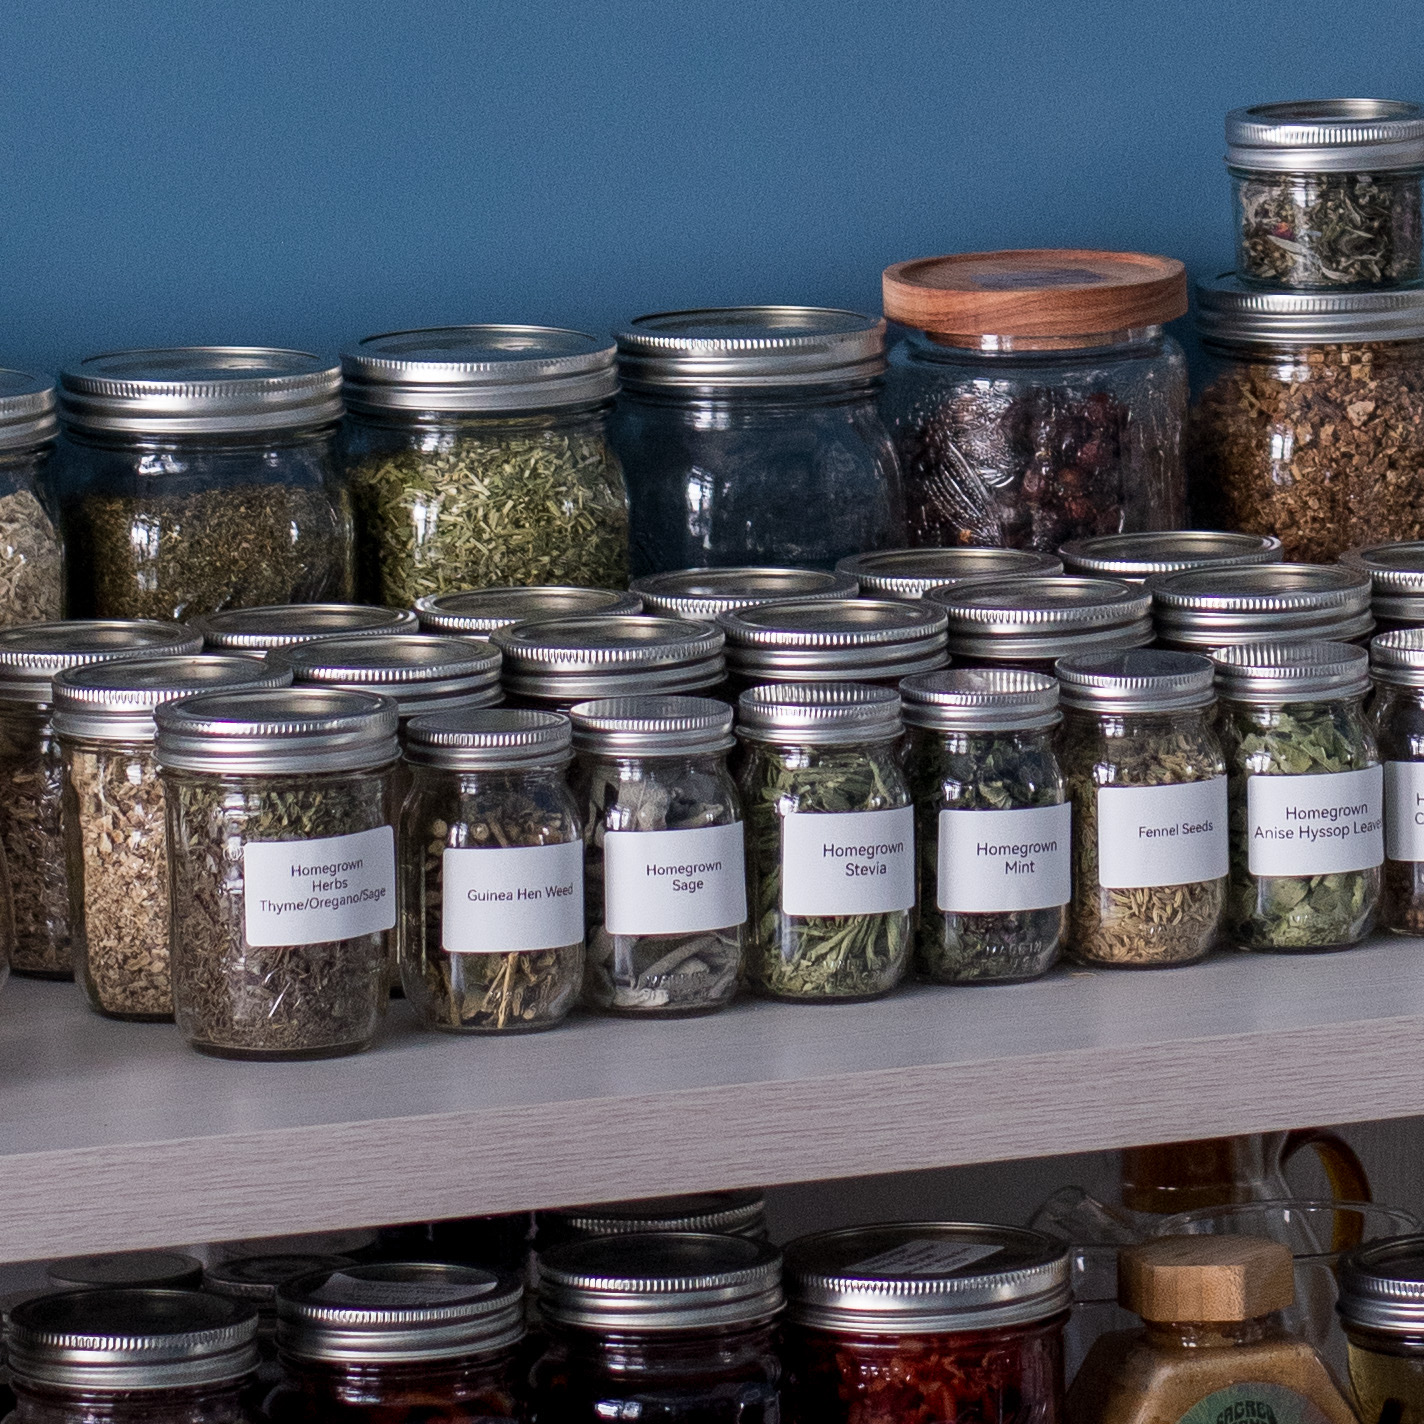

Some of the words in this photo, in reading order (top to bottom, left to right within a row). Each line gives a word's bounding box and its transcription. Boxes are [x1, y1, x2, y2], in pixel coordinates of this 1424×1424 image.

[1286, 803, 1368, 822] Homegrown
[1139, 824, 1179, 839] Fennel
[1182, 819, 1213, 835] Seeds
[1254, 826, 1294, 839] Anise
[1300, 824, 1350, 842] Hyssop
[823, 841, 904, 859] Homegrown
[976, 840, 1058, 858] Homegrown
[291, 858, 364, 877] Homegrown
[646, 861, 722, 877] Homegrown
[845, 861, 887, 877] Stevia
[1005, 860, 1035, 875] Mint
[312, 877, 349, 893] Herbs
[467, 888, 513, 902] Guinea
[517, 888, 542, 901] Hen
[545, 882, 573, 899] Weed
[672, 879, 704, 894] Sage
[259, 886, 387, 915] Thyme/Oregano/Sage
